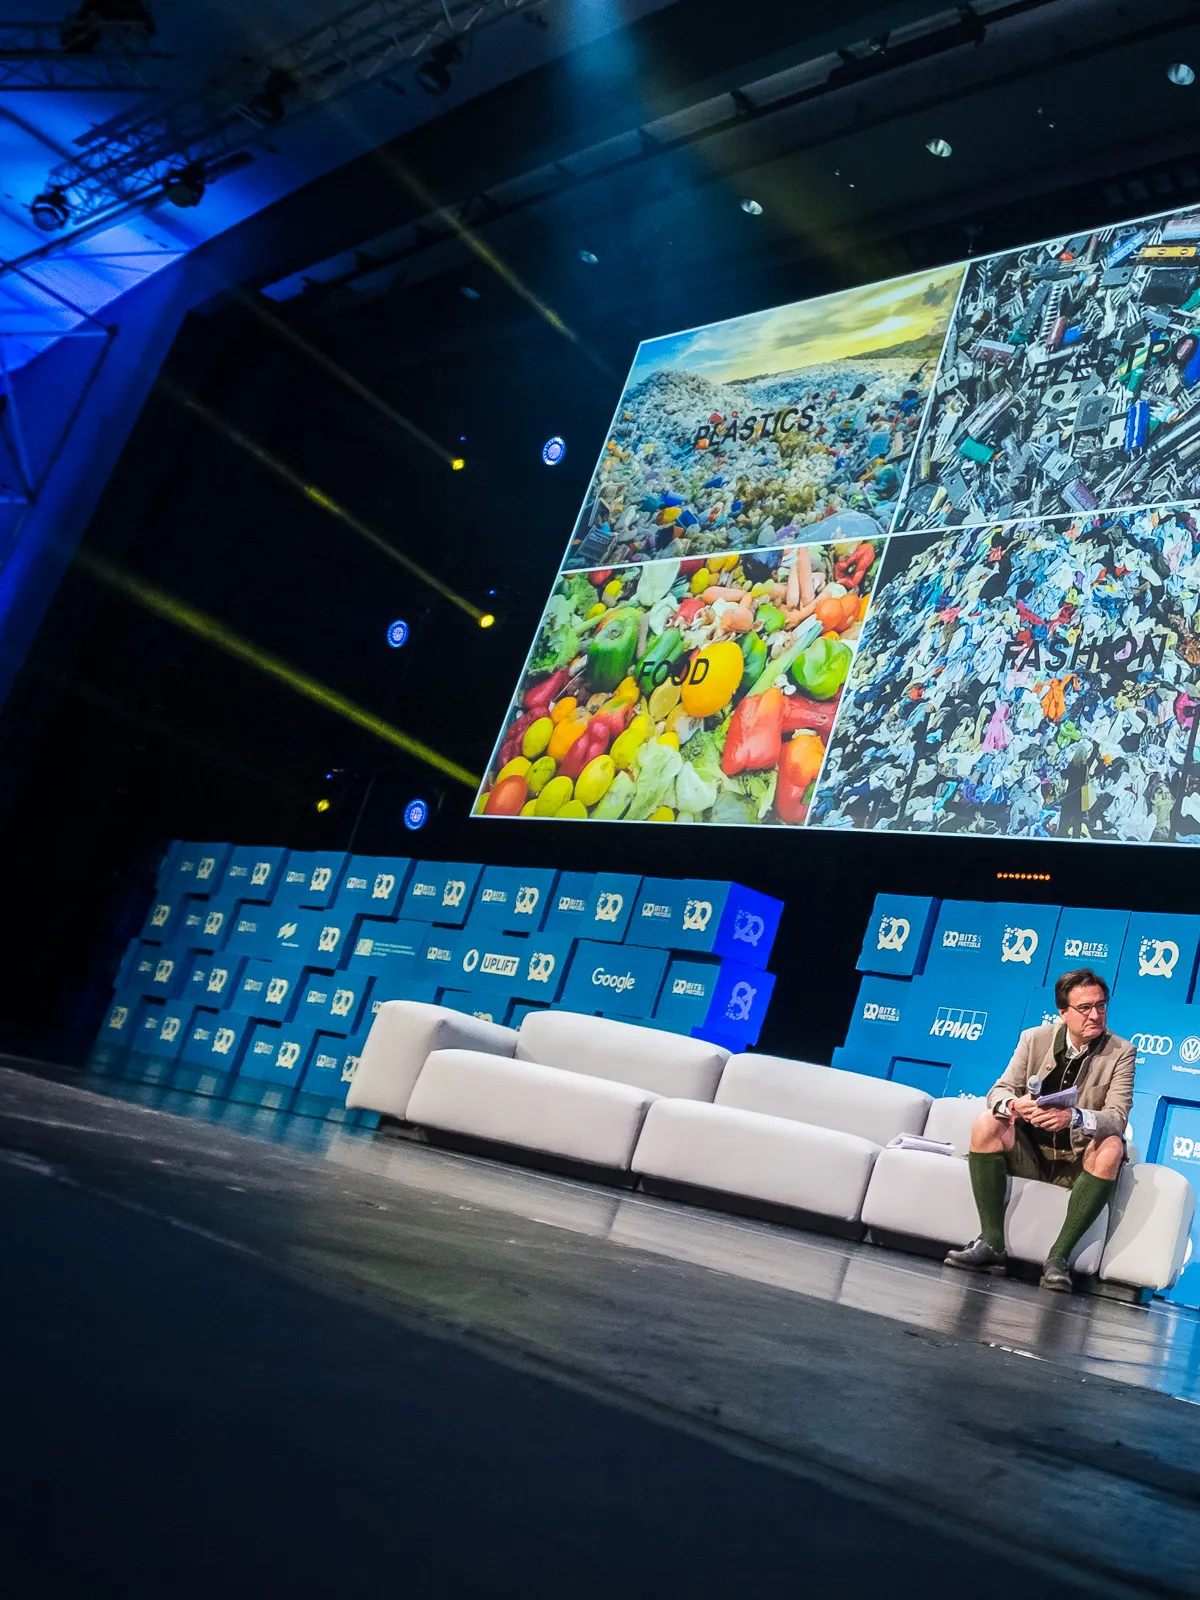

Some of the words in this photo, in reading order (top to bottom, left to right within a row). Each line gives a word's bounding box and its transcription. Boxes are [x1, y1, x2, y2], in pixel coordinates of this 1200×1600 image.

[694, 404, 816, 449] PLASTICS
[1000, 633, 1168, 673] FASHION
[635, 658, 709, 688] FOOD
[483, 956, 517, 973] UPLIFT
[592, 967, 636, 993] Google
[929, 1019, 983, 1041] KPMG
